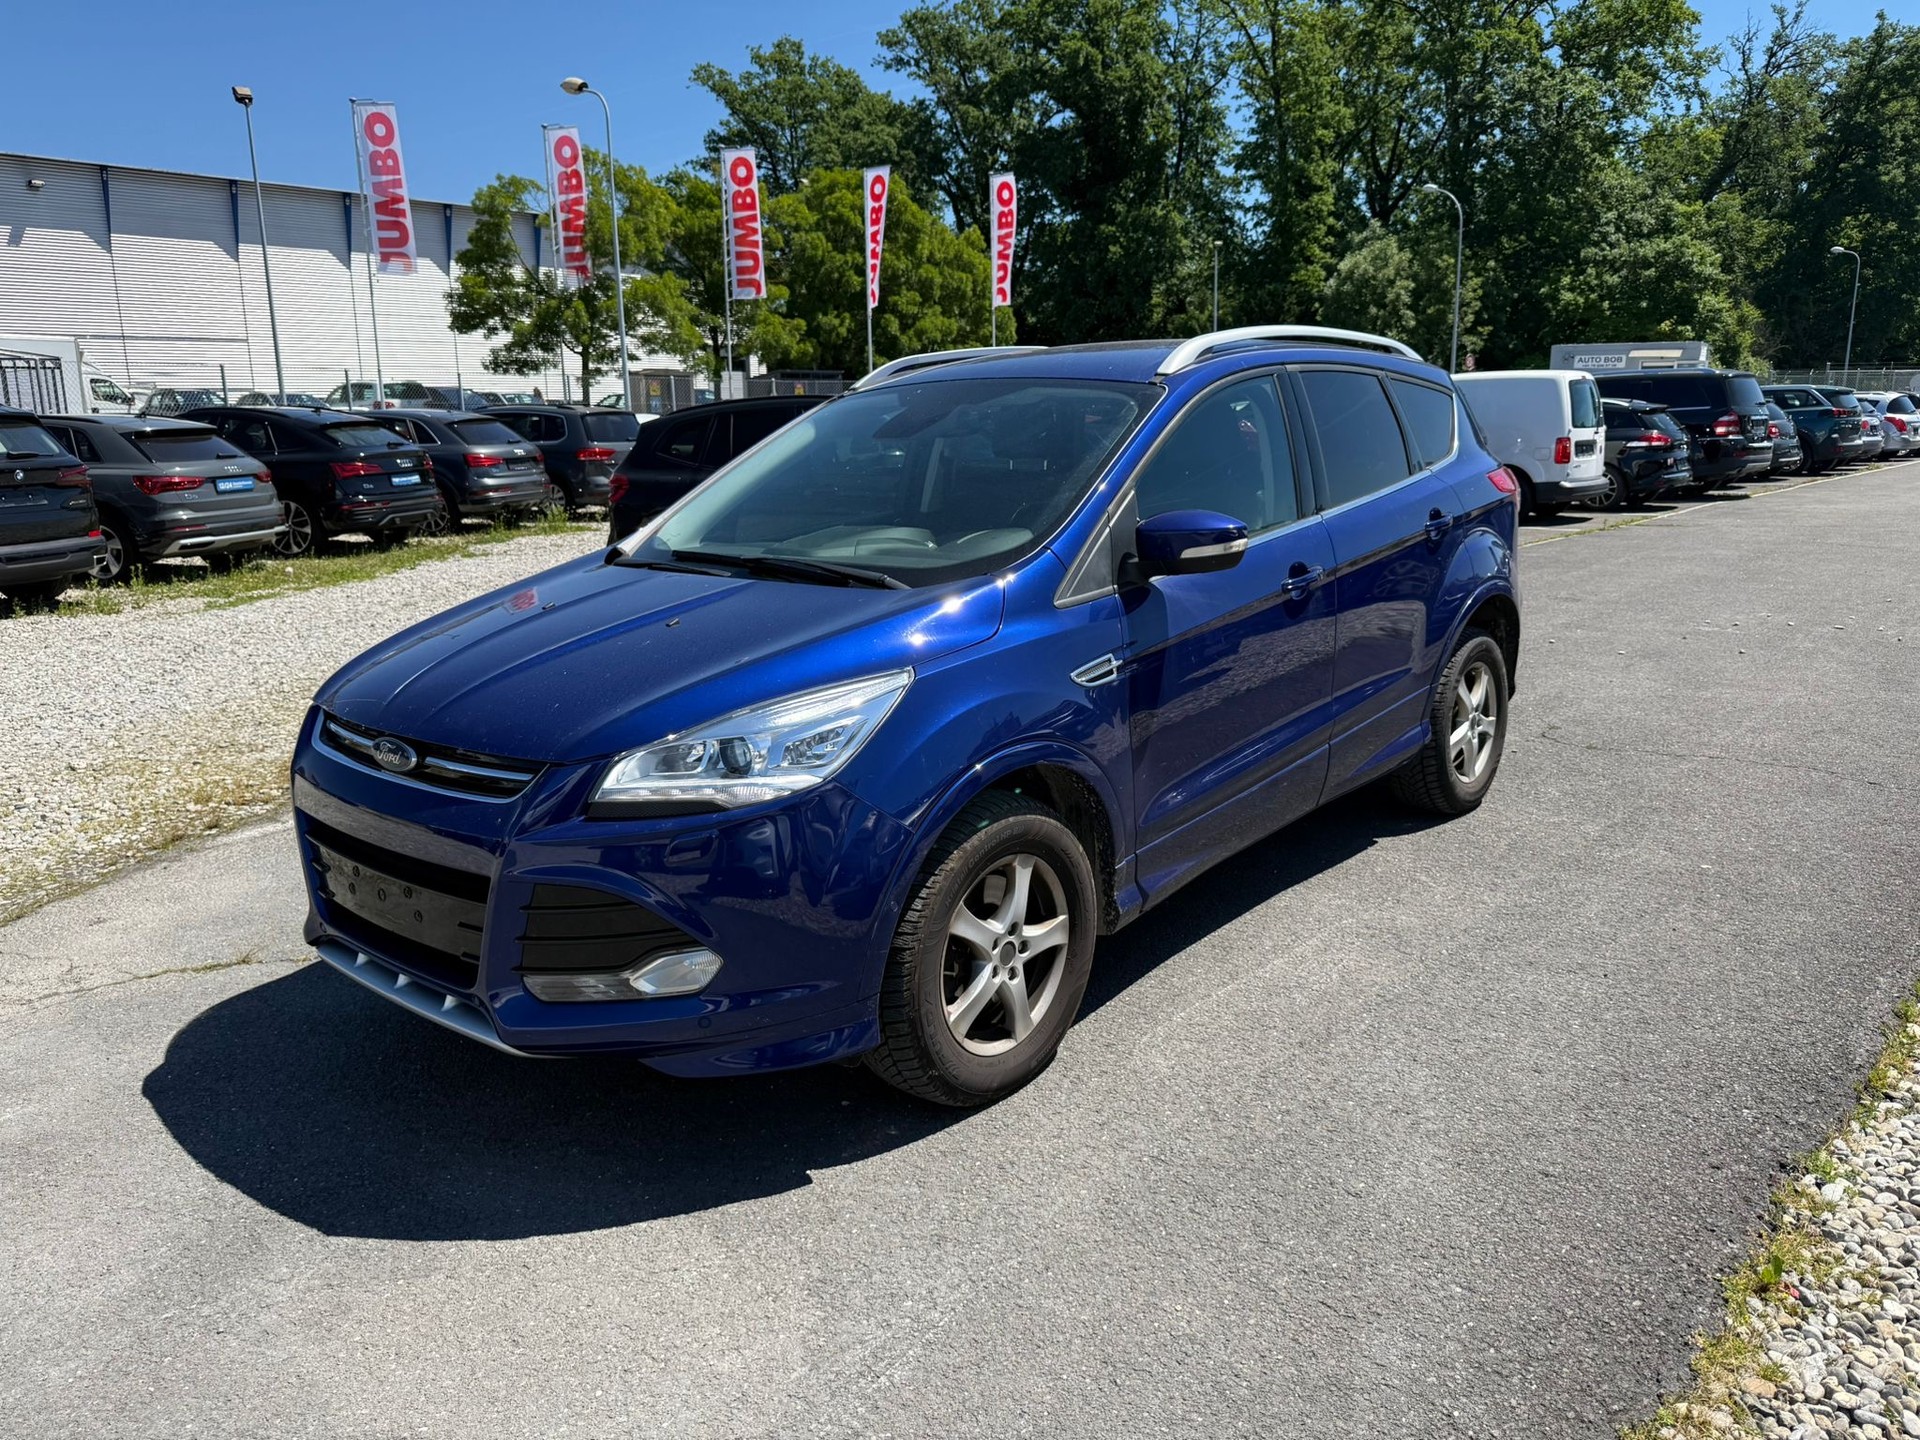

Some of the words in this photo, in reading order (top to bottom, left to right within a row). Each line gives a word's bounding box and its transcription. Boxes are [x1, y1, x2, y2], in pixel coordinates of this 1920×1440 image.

[364, 112, 413, 271] JUMBO
[553, 135, 592, 280] JUMBO
[730, 157, 763, 296] JUMBO
[996, 180, 1016, 304] JUMBO
[376, 741, 402, 765] Ford
